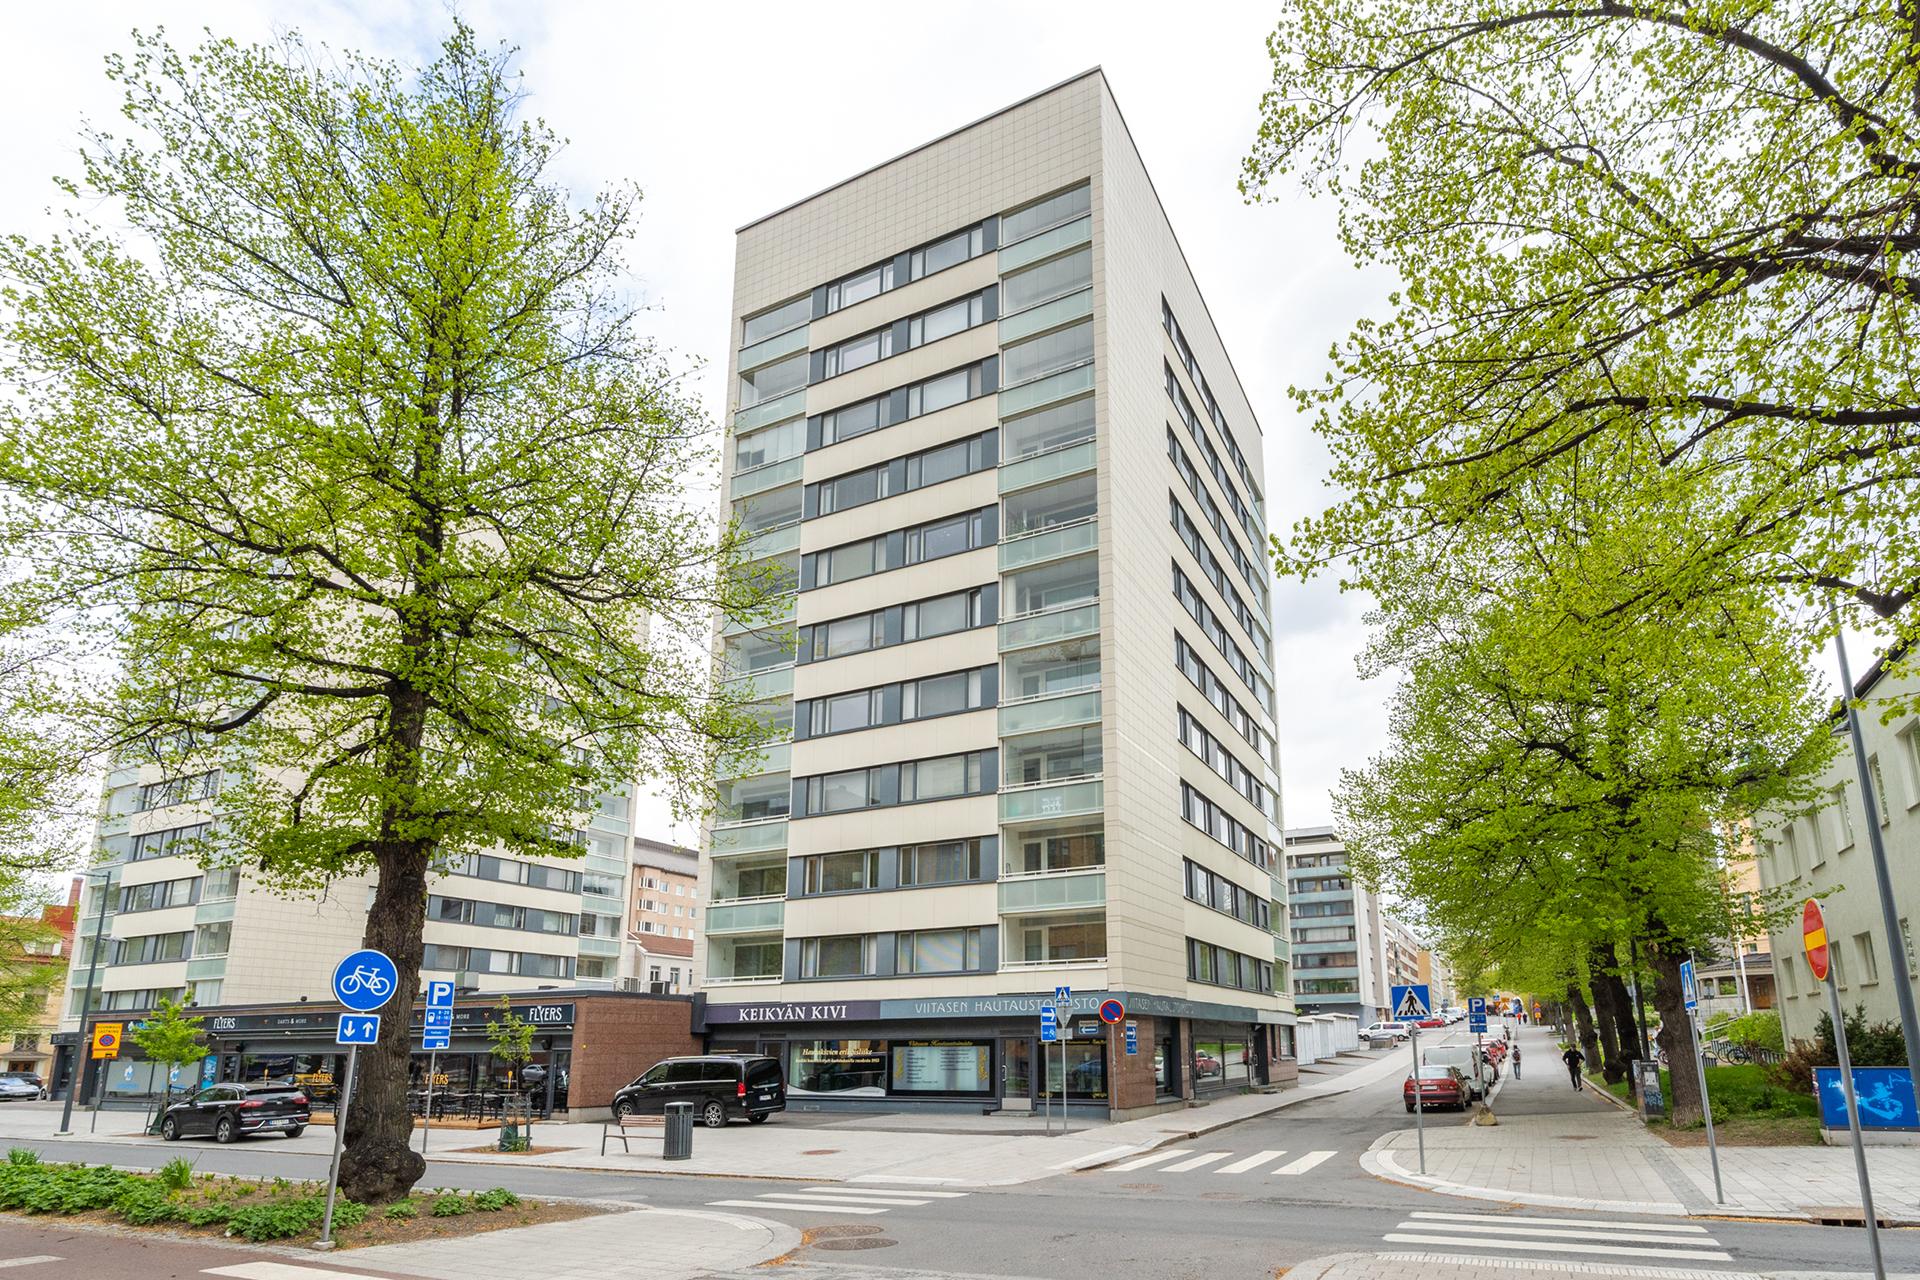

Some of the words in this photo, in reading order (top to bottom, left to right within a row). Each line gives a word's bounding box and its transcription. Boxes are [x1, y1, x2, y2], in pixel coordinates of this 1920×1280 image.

[432, 983, 451, 1005] P
[738, 1004, 806, 1021] KEIKYÄN
[811, 1005, 847, 1019] KIVI
[915, 1001, 968, 1014] VIITASEN
[975, 997, 1100, 1012] HAUTAUSTOISTO
[1472, 998, 1483, 1012] P
[213, 1017, 236, 1029] FLYERS
[529, 1006, 563, 1024] FLYERS
[425, 1073, 449, 1085] FYERS
